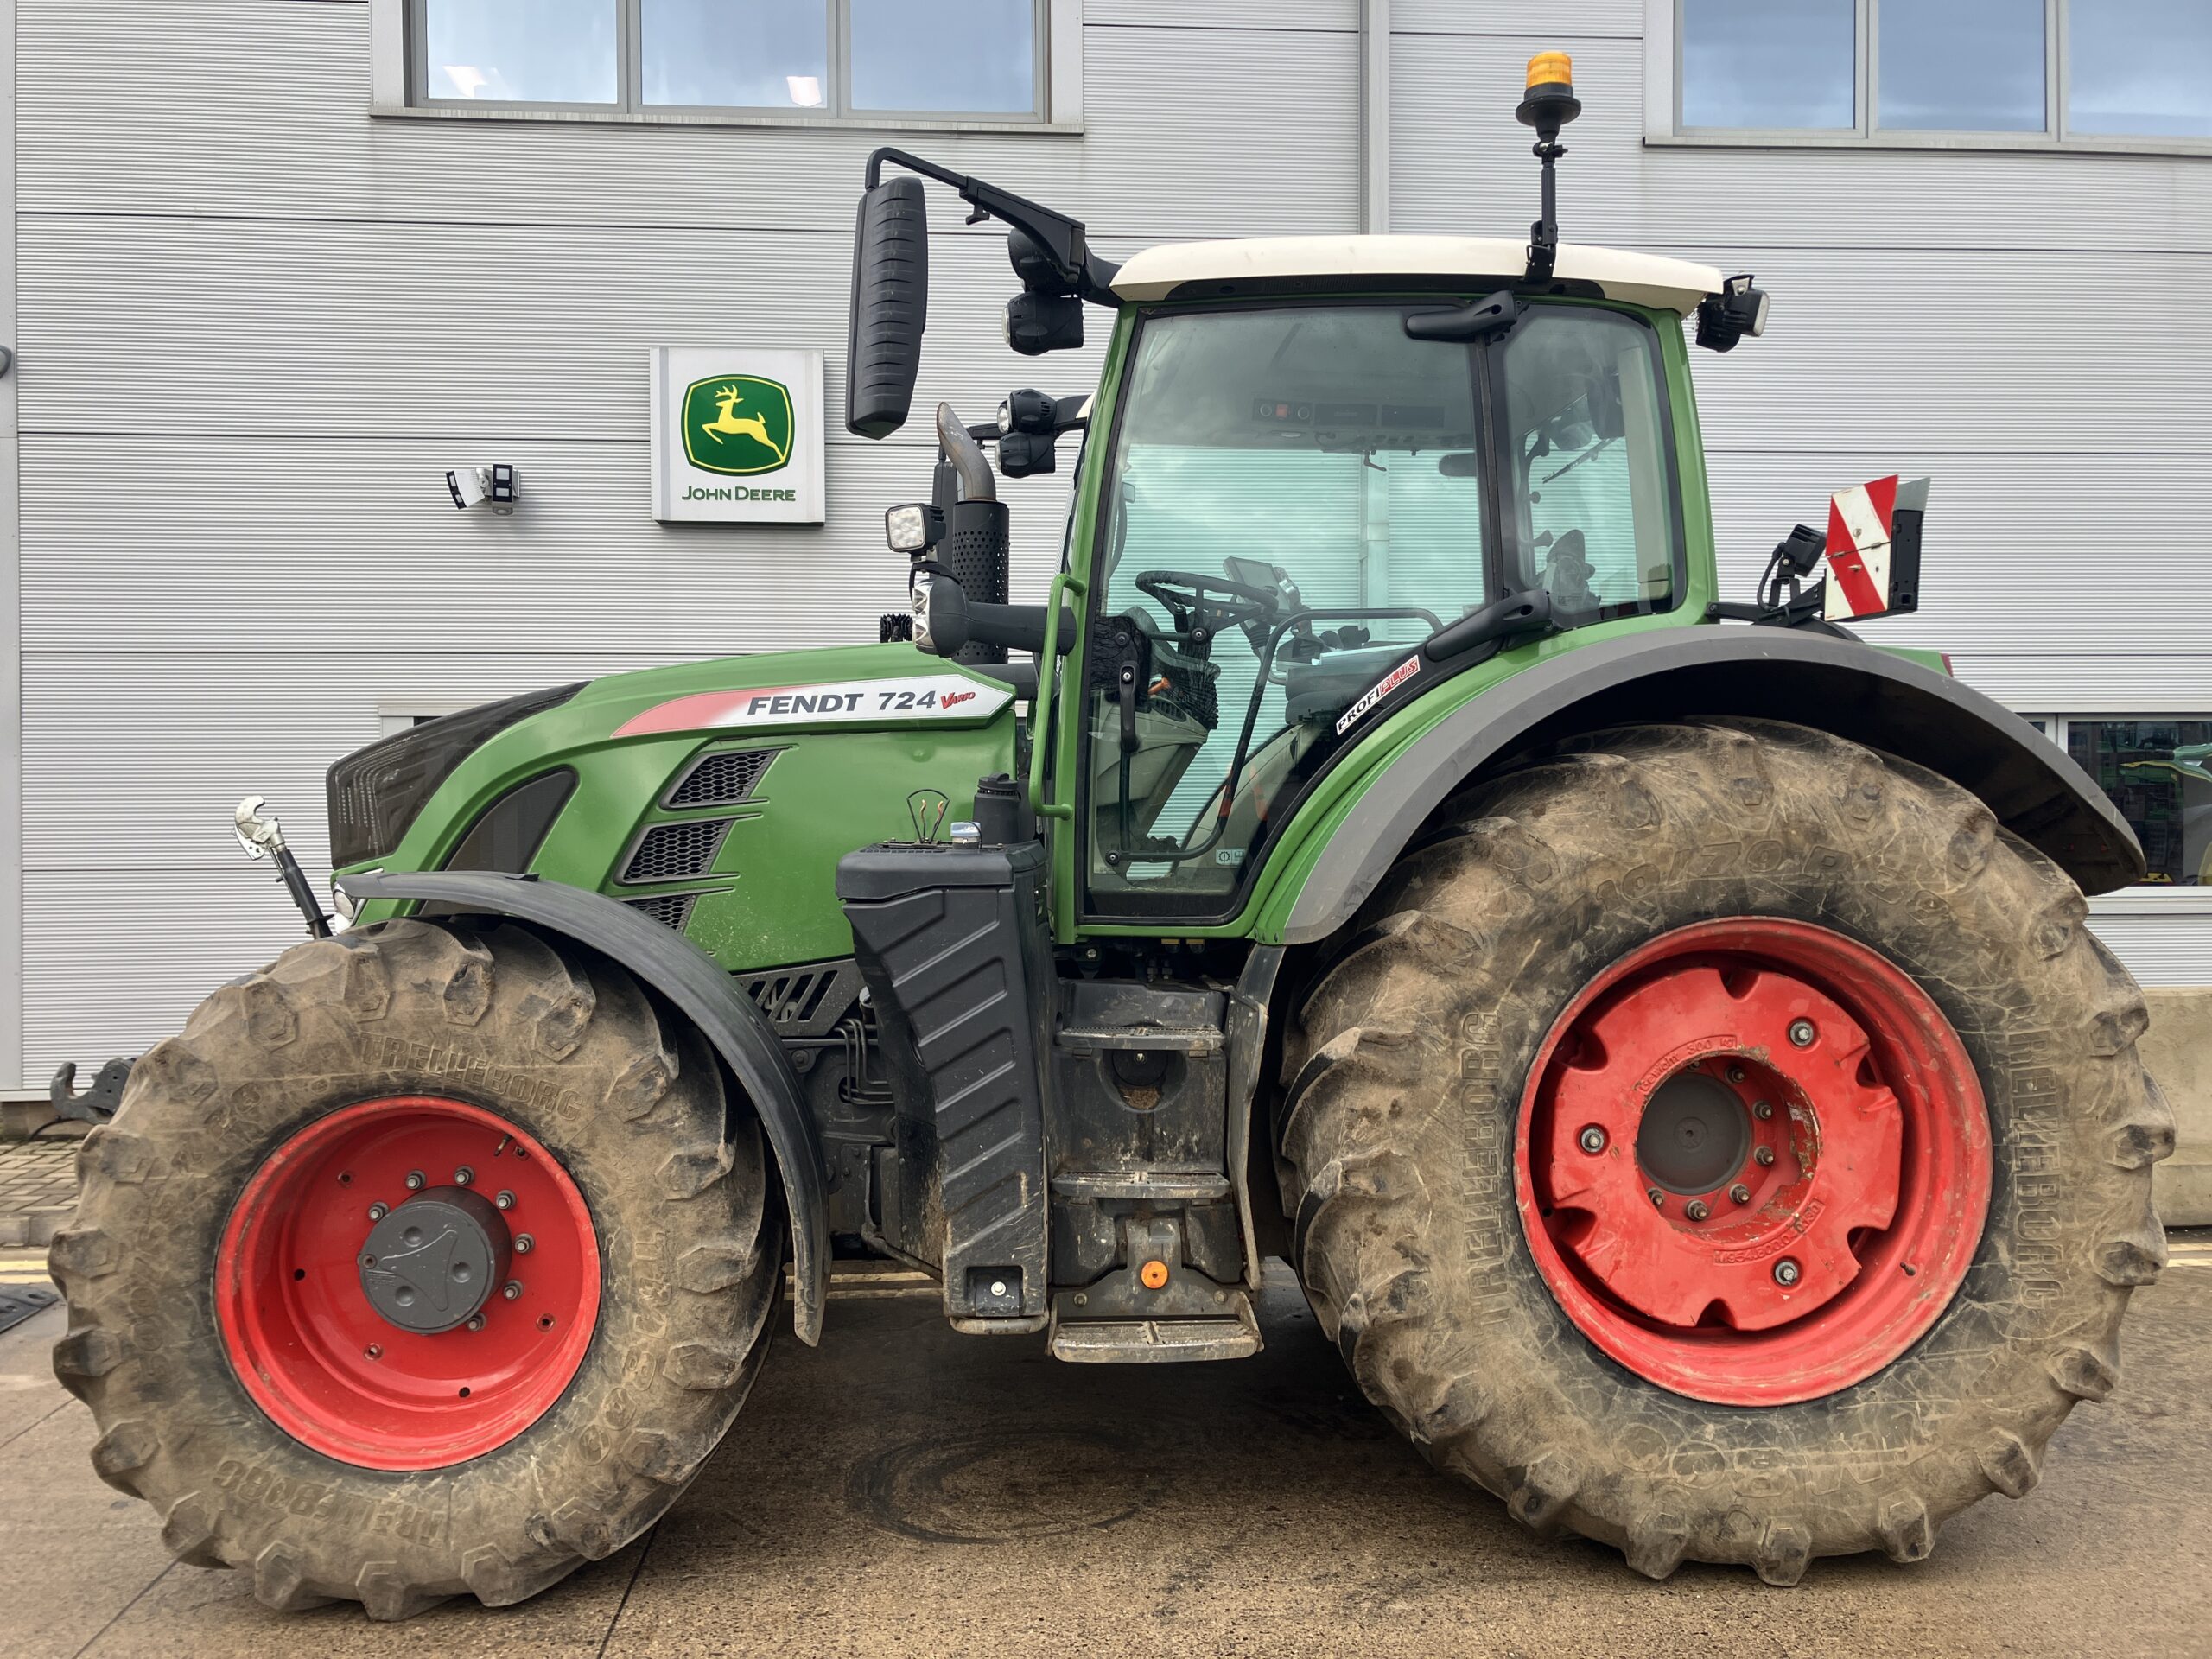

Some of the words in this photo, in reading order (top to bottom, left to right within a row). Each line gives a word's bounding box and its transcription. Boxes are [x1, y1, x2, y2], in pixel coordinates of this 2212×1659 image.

[682, 486, 732, 501] JOHN
[734, 486, 796, 501] DEERE
[747, 694, 863, 715] FENDT
[877, 690, 937, 710] 724
[358, 1031, 585, 1122] TRELLEBORG
[1461, 1011, 1512, 1338] TRELLEBORG
[2006, 1005, 2065, 1311] TRELLEBORG
